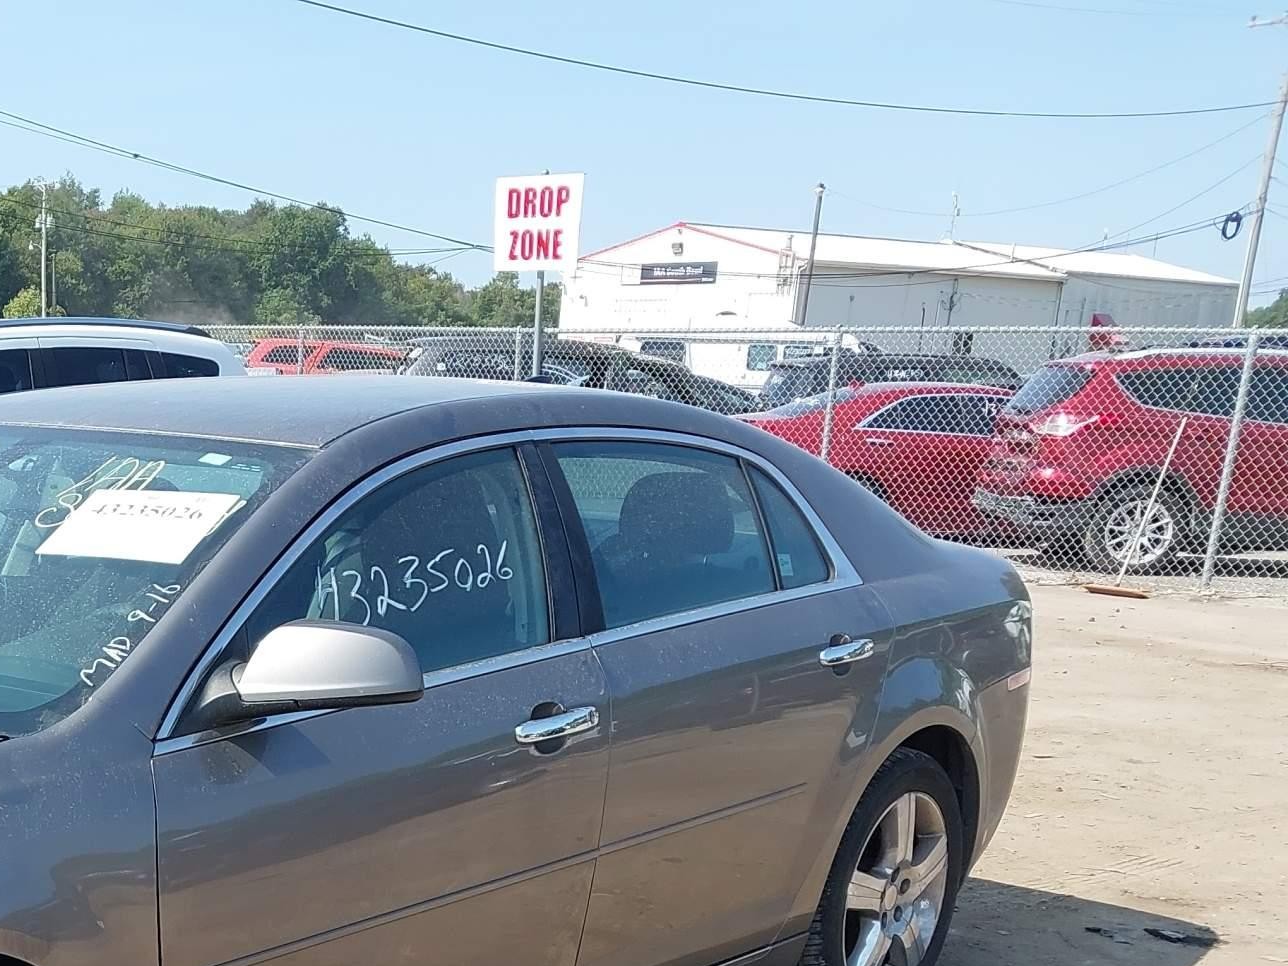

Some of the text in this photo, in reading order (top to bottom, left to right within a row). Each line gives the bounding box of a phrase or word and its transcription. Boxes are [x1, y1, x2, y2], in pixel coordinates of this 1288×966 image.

[507, 185, 570, 219] DROP
[508, 229, 563, 261] ZONE
[79, 583, 181, 686] MAD 9-16
